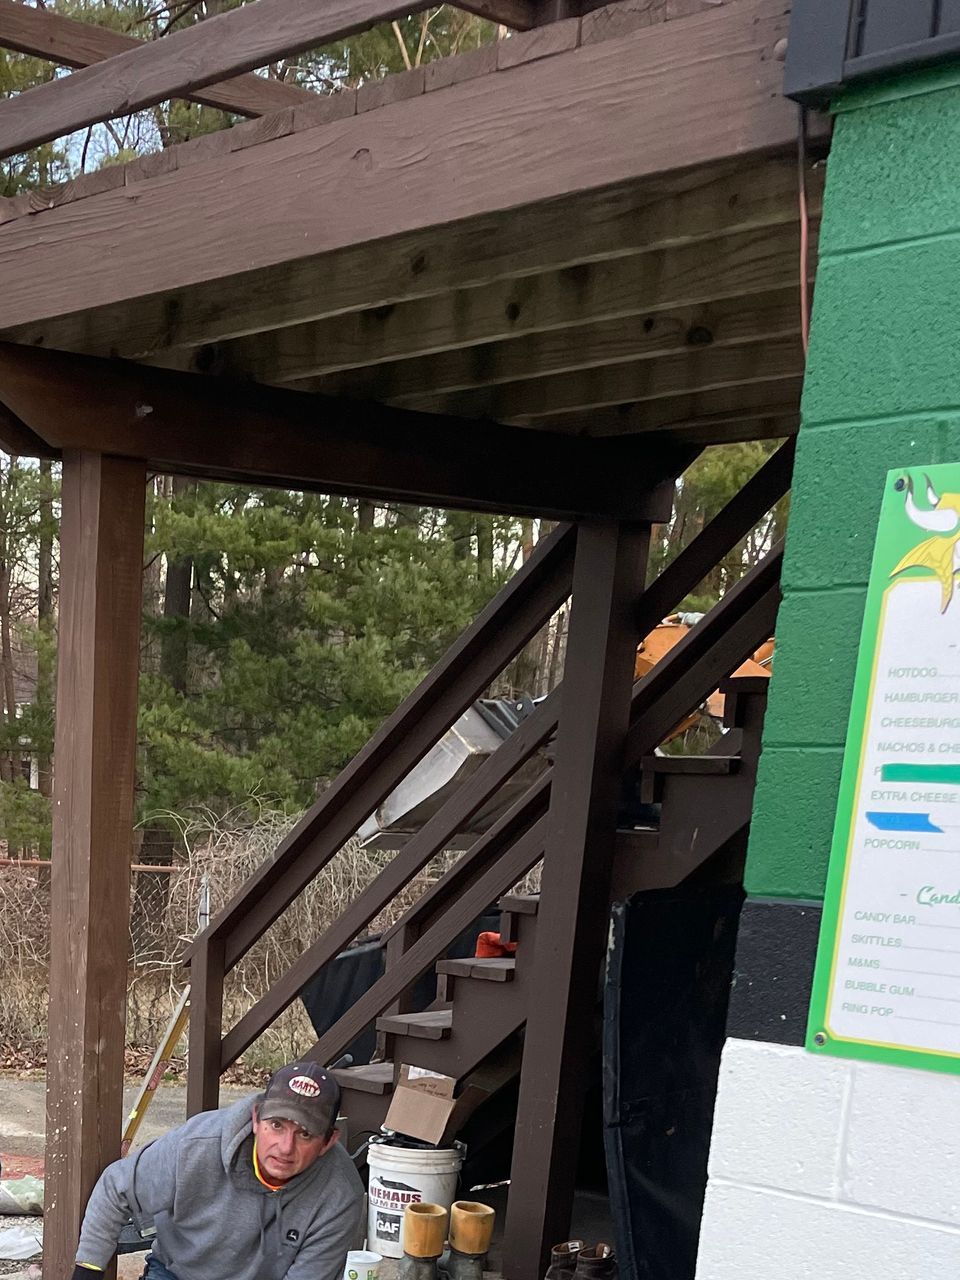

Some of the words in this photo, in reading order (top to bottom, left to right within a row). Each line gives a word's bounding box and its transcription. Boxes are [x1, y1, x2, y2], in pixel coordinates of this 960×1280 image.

[888, 667, 937, 678] HOTDOG
[884, 692, 959, 704] HAMBURGER
[877, 742, 925, 753] NACHOS
[928, 742, 935, 753] &
[870, 790, 907, 802] EXTRA
[910, 791, 958, 804] CHEESE
[864, 838, 921, 850] POPCORN
[916, 885, 960, 911] Cand
[854, 911, 892, 923] CANDY
[893, 914, 916, 926] BAR
[851, 934, 903, 948] SKITTLES
[847, 957, 881, 969] M&MS
[844, 979, 887, 993] BUBBLE
[889, 985, 916, 996] GUM
[841, 1002, 869, 1014] RING
[870, 1006, 895, 1017] POP
[370, 1197, 408, 1210] LUMBE
[376, 1220, 400, 1234] GAF
